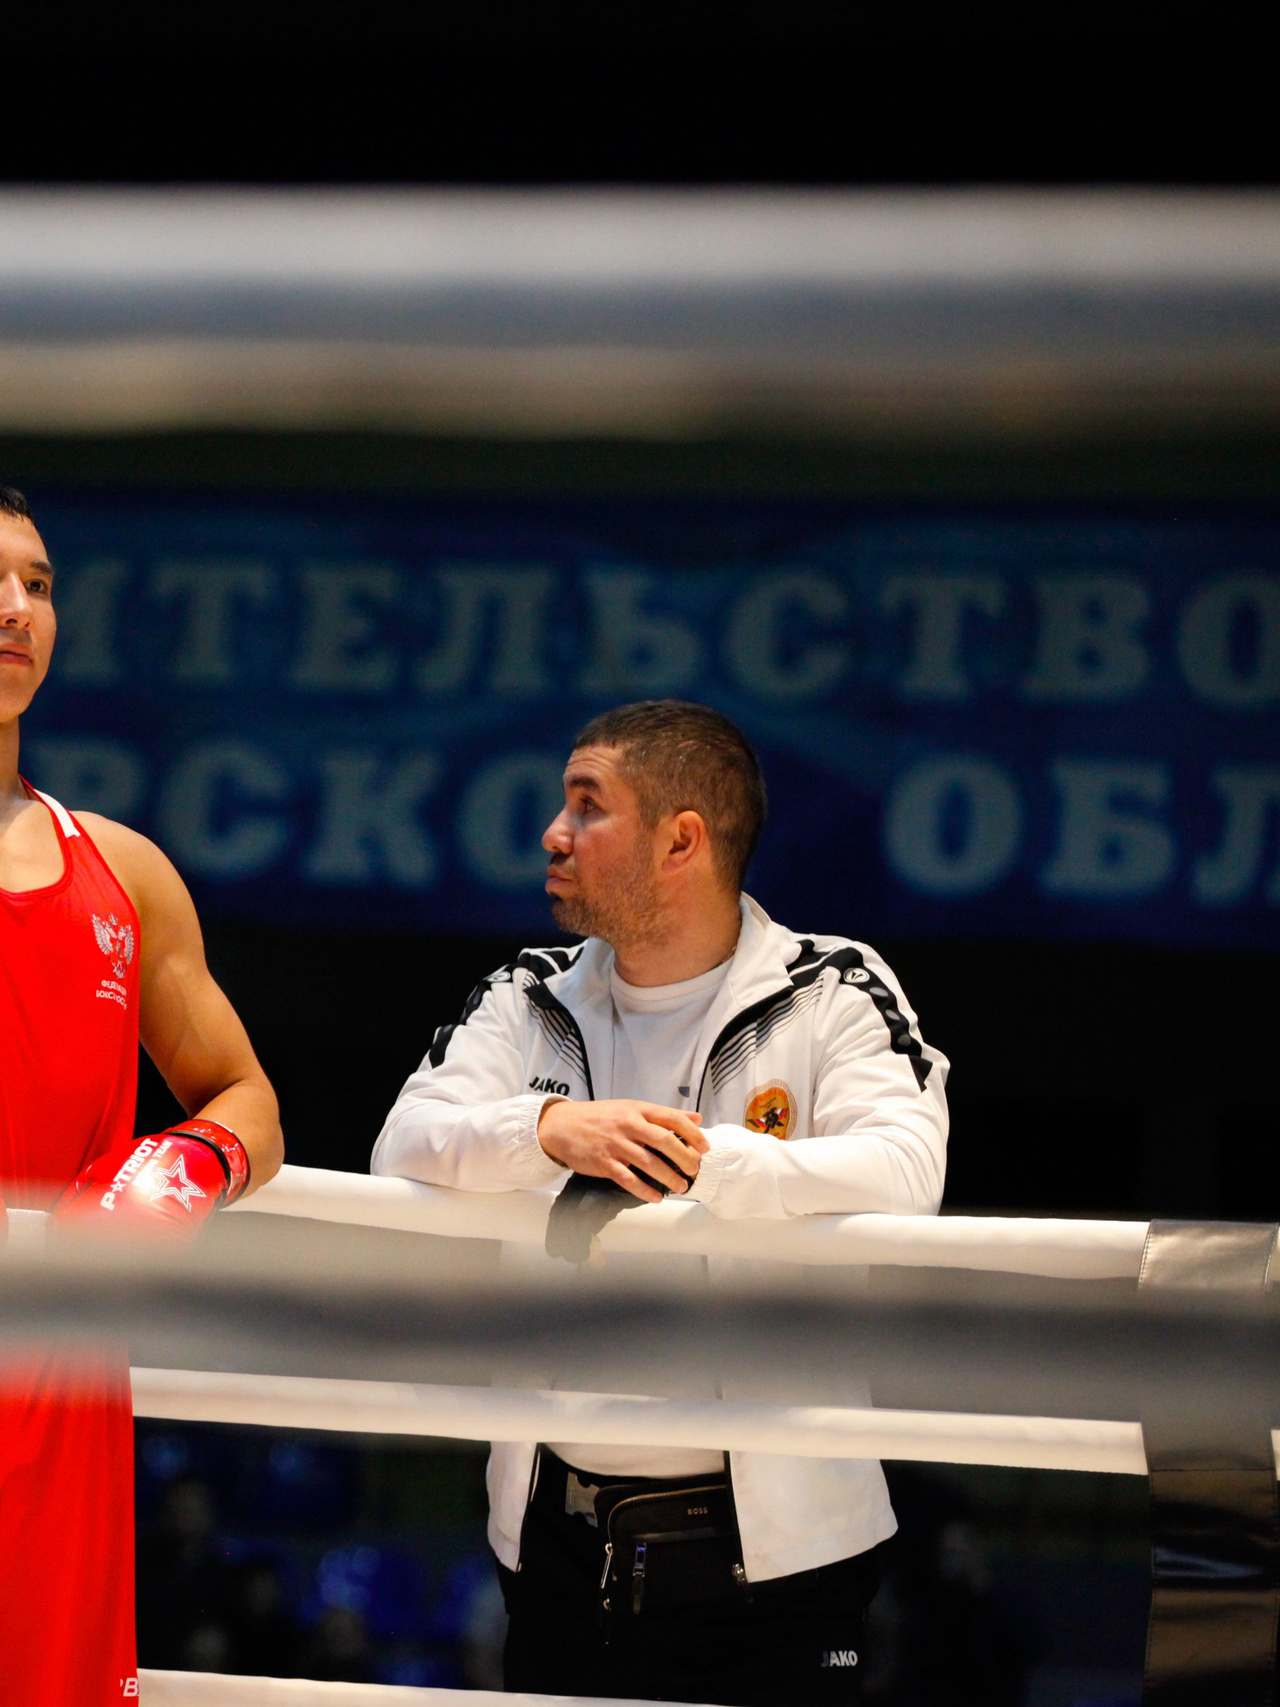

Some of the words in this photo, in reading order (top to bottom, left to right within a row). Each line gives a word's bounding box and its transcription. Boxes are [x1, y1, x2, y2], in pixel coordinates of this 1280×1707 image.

[528, 1076, 570, 1096] JAKO
[153, 1139, 173, 1158] TEAM
[686, 1506, 709, 1516] BOSS
[820, 1650, 858, 1667] JAKO
